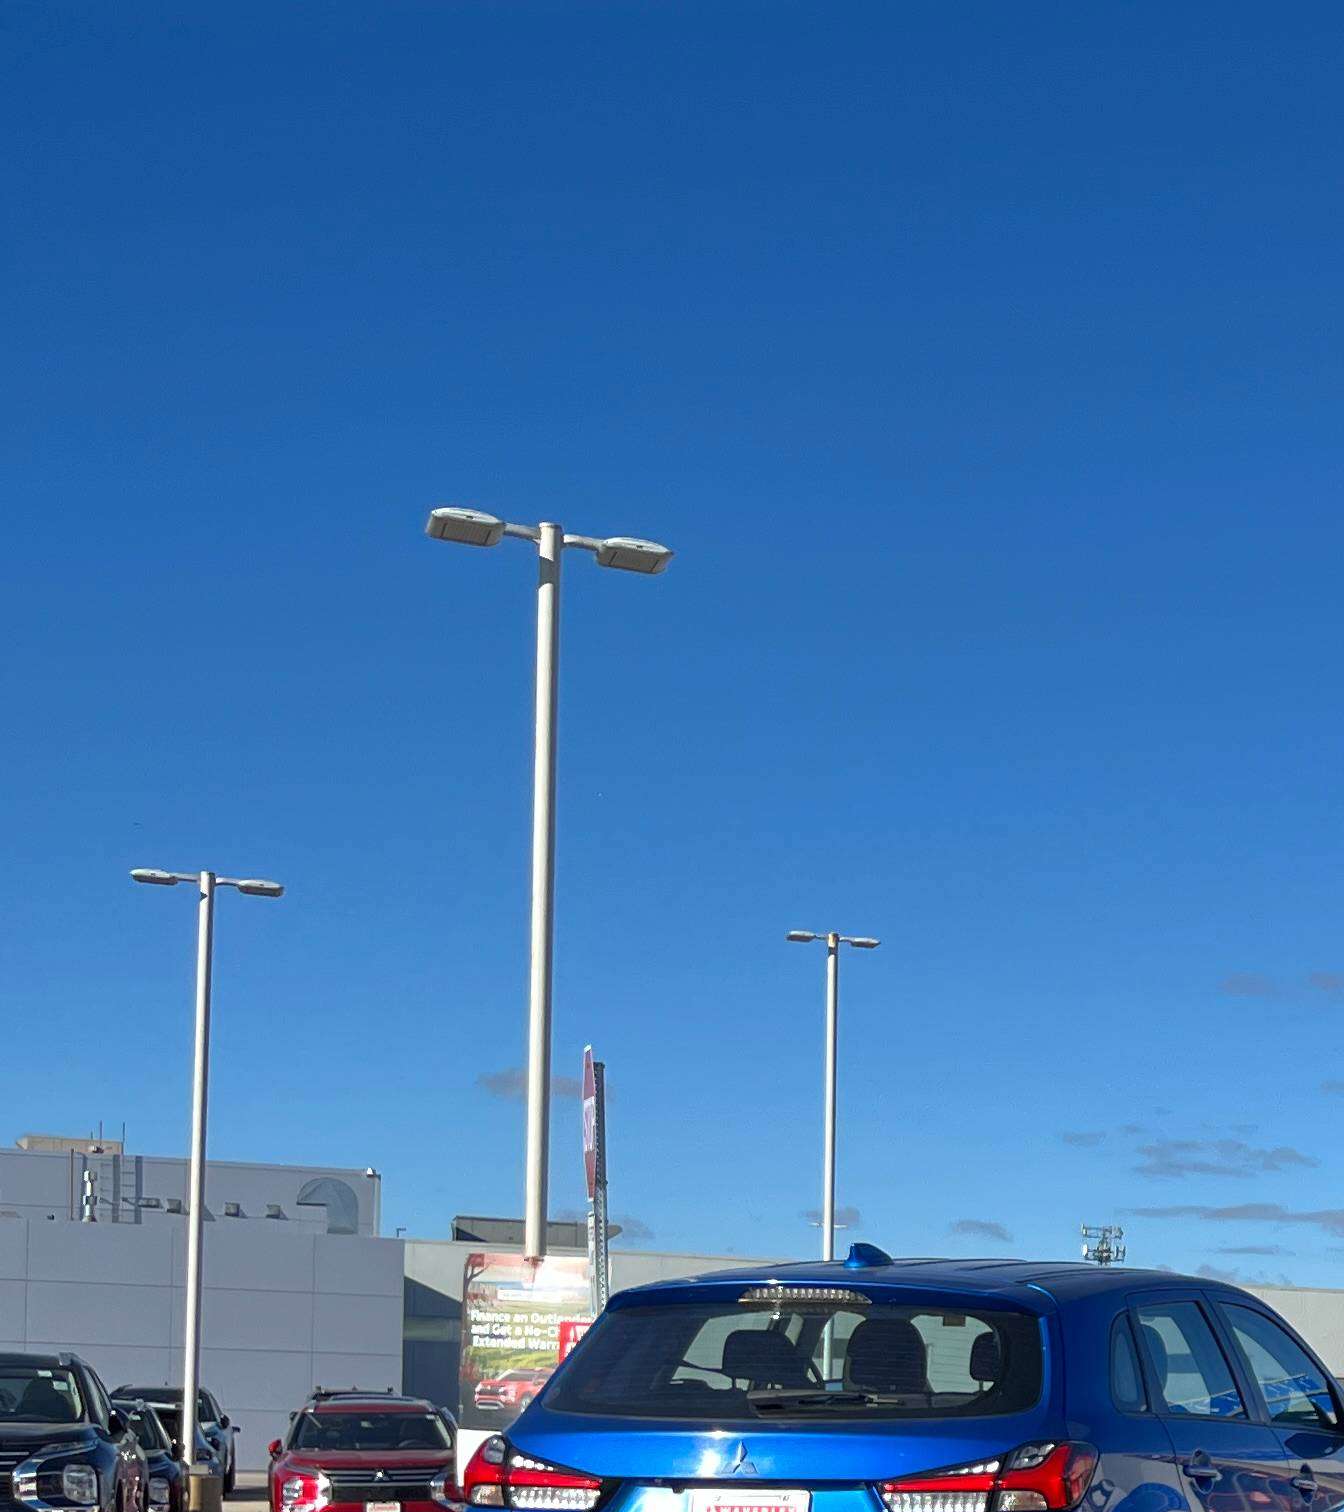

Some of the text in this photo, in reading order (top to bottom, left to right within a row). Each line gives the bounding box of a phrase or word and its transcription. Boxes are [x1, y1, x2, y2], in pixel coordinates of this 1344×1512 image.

[470, 1310, 511, 1323] Finance
[513, 1314, 528, 1323] an
[470, 1324, 491, 1335] and
[473, 1336, 526, 1349] Extended
